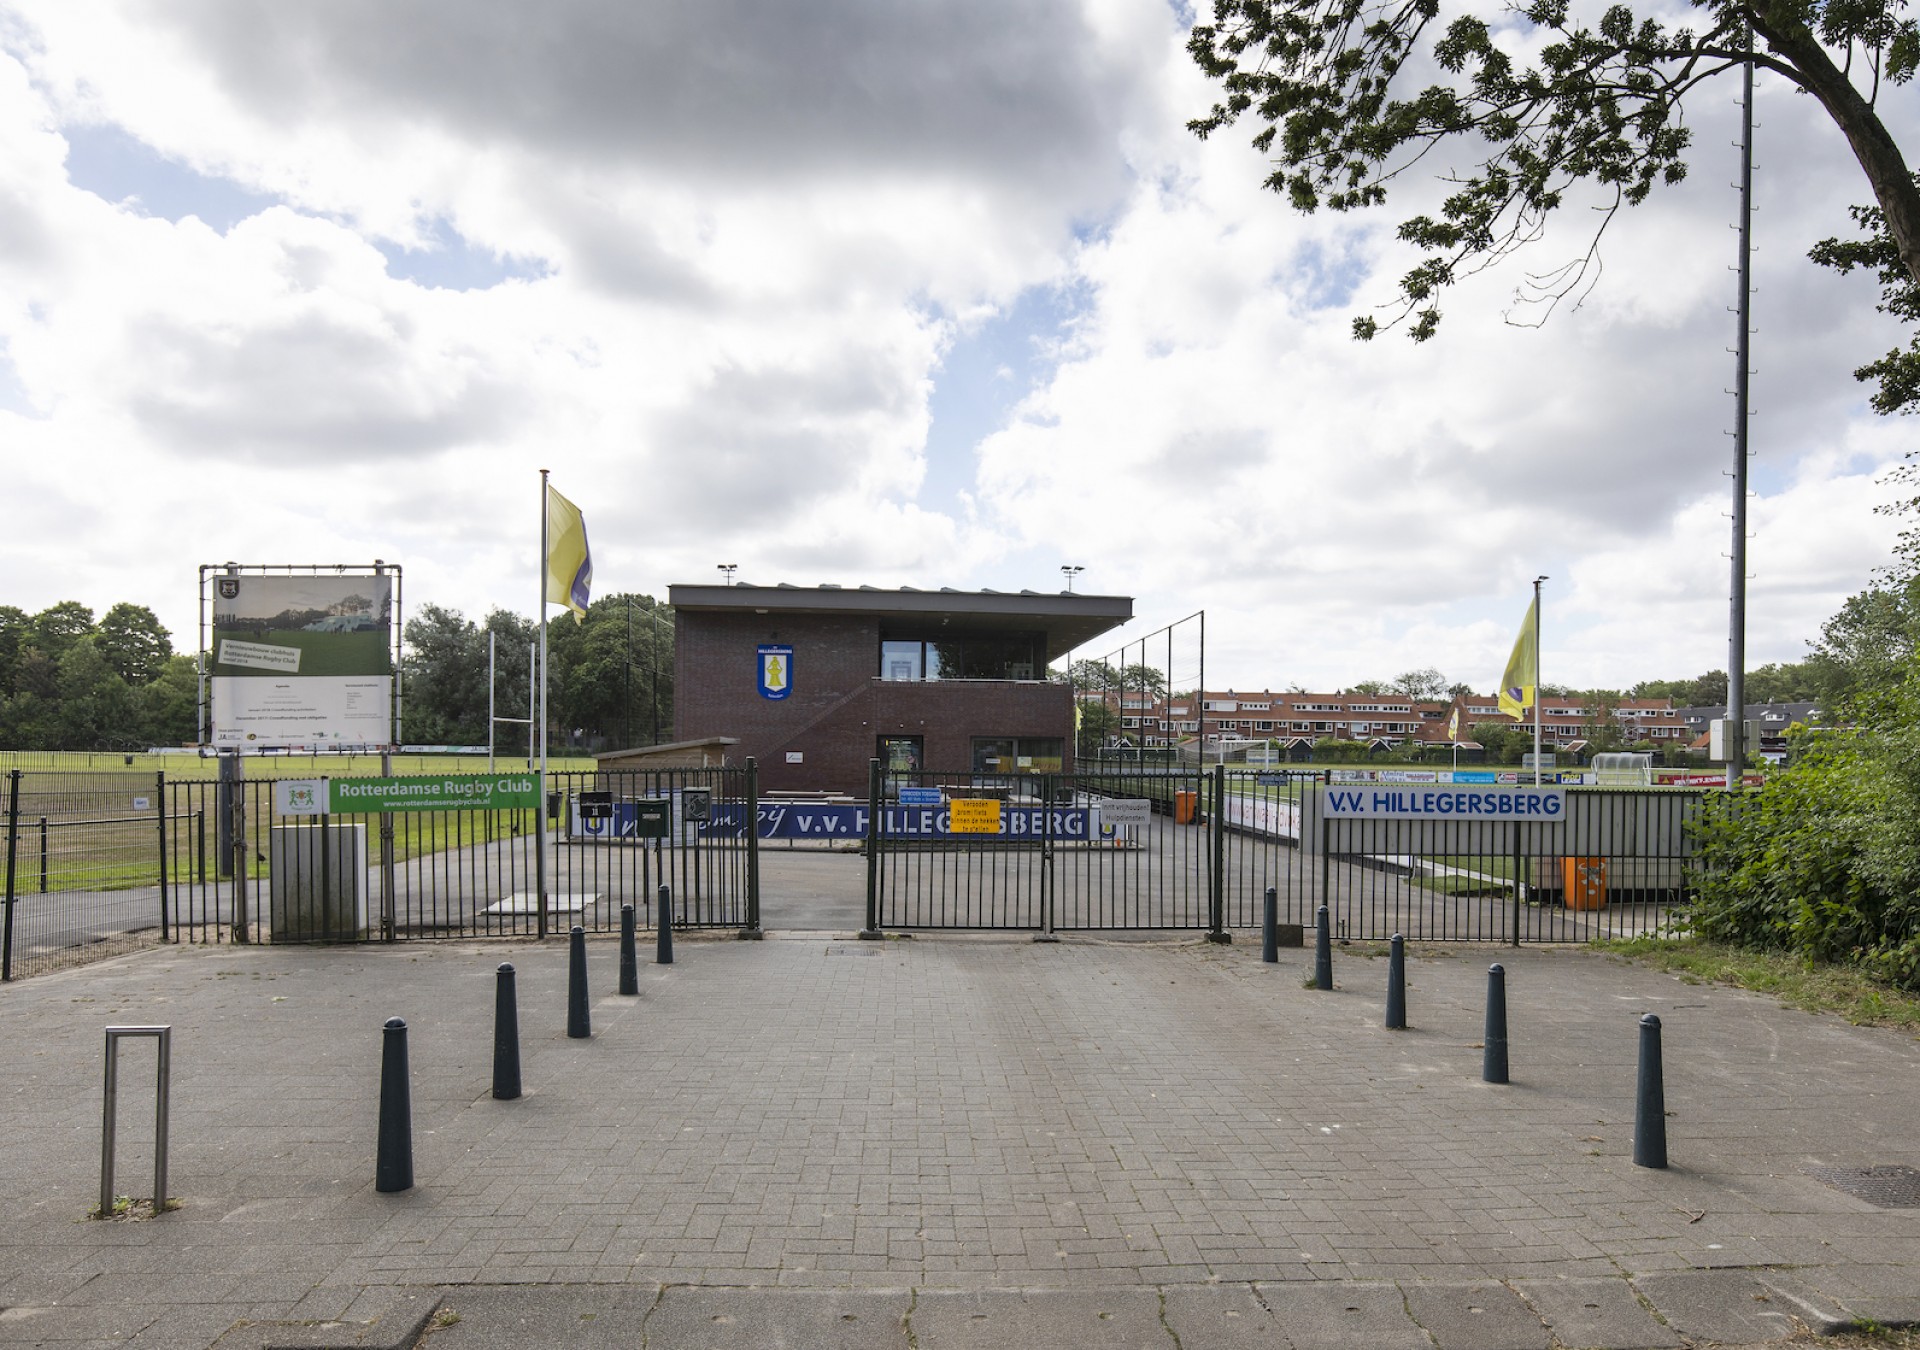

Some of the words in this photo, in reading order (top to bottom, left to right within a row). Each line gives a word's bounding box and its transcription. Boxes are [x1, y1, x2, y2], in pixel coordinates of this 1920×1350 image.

[224, 650, 262, 660] Rotterdamse
[263, 655, 282, 663] Rugby
[340, 782, 441, 797] Rotterdamse
[444, 780, 494, 797] Rugby
[497, 779, 533, 793] Club
[383, 798, 491, 807] www.rotterdamserugbyclub.nl
[1329, 792, 1364, 812] V.V.
[1373, 792, 1561, 815] HILLEGERSBERG
[797, 815, 847, 833] v.v.
[856, 810, 1083, 835] HILLEGSBERG
